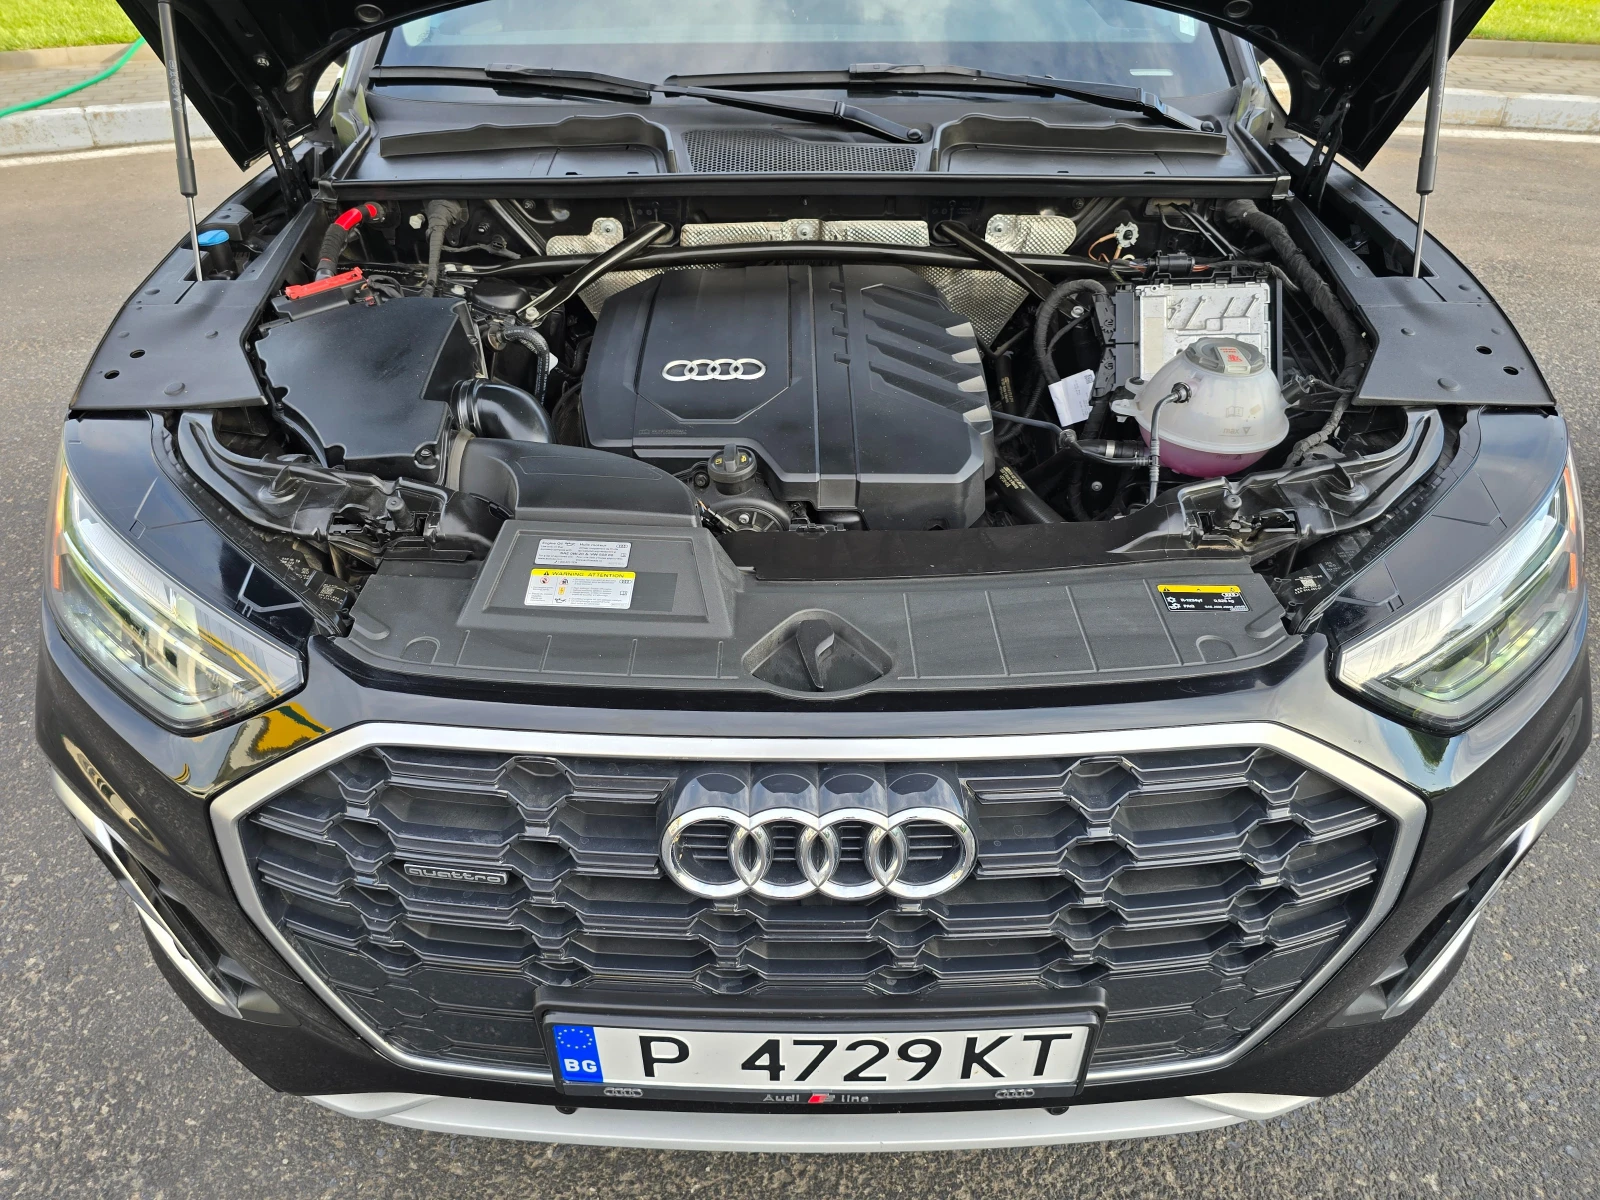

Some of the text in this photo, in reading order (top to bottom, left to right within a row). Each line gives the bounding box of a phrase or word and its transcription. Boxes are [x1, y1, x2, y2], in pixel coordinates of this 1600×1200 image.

[408, 867, 501, 883] quattro
[638, 1035, 690, 1078] P
[563, 1058, 598, 1073] BG
[762, 1093, 800, 1102] Audi
[841, 1094, 869, 1103] line
